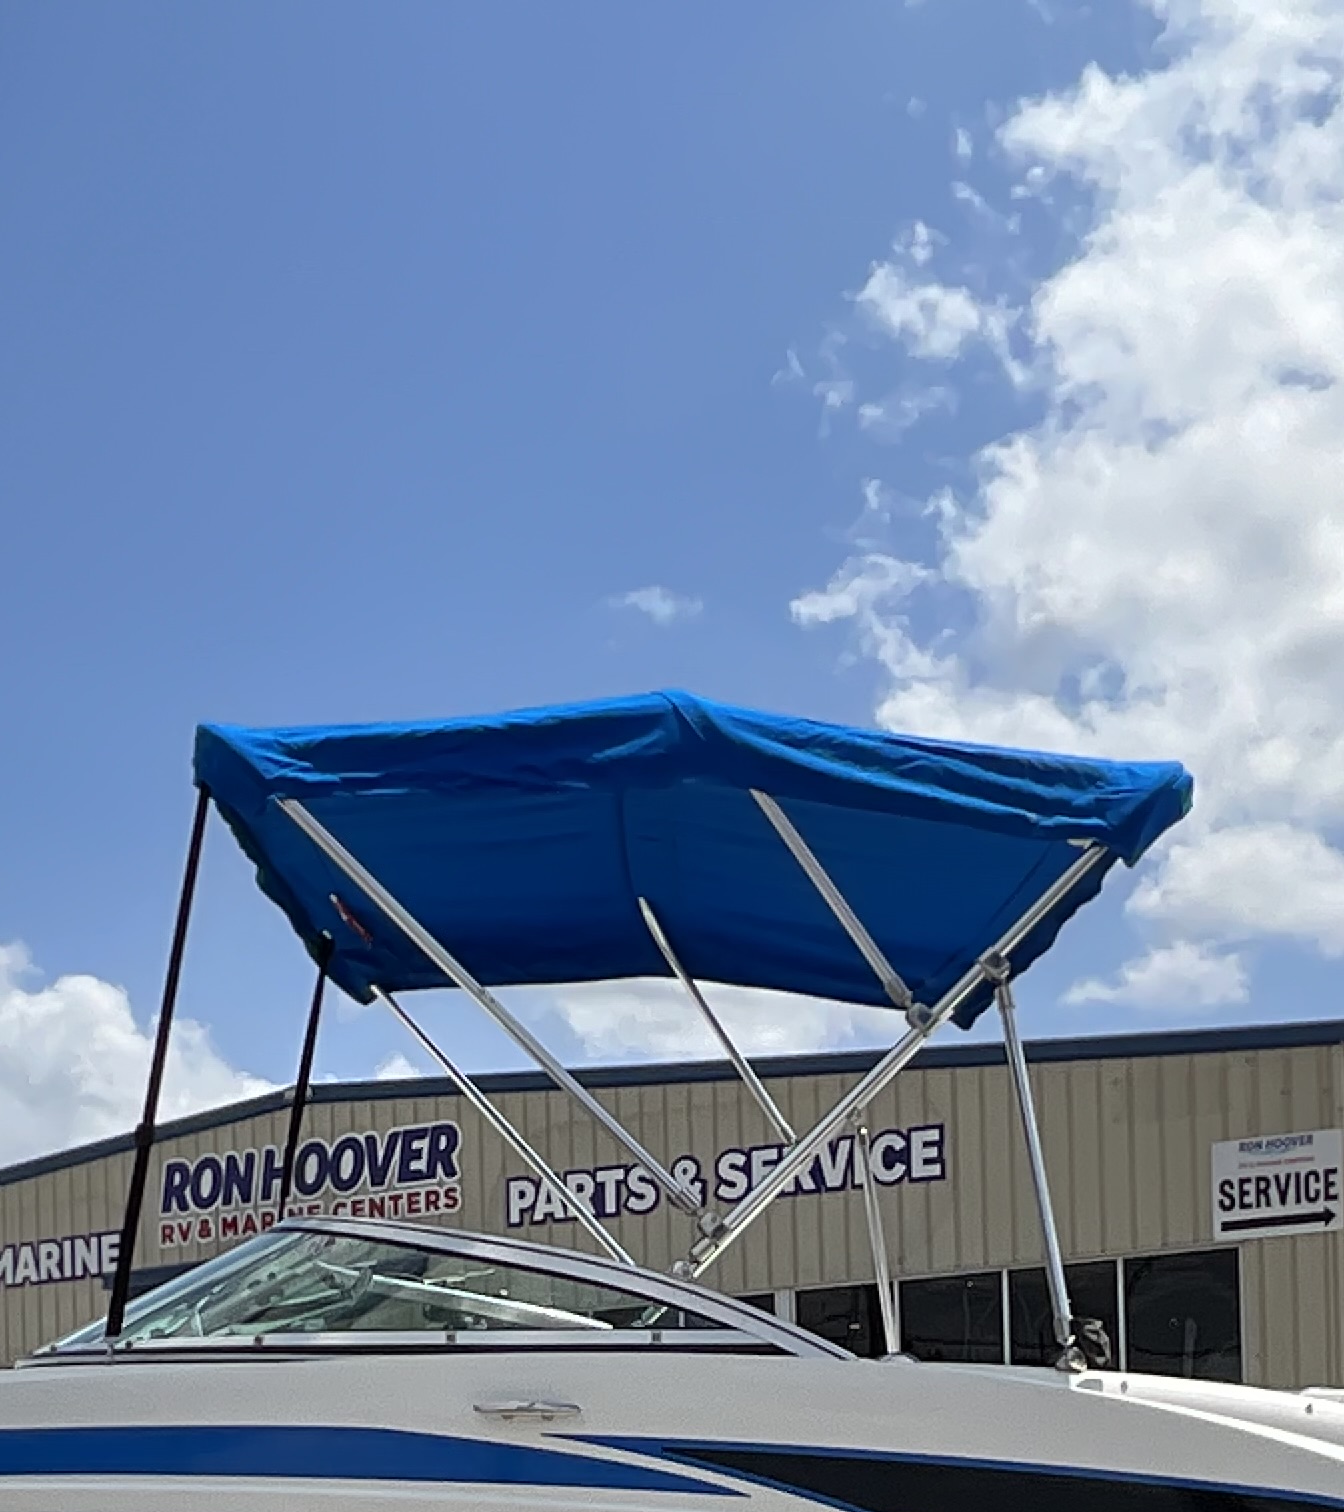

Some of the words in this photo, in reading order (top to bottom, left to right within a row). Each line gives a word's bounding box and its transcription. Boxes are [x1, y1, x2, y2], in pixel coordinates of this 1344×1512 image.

[161, 1152, 255, 1214] RON
[261, 1123, 459, 1201] HOOVER
[506, 1163, 660, 1228] PARTS
[670, 1154, 707, 1211] &
[714, 1122, 946, 1205] SERVICE
[1218, 1167, 1339, 1212] SERVICE
[161, 1220, 193, 1244] RV
[197, 1218, 212, 1240] &
[221, 1204, 322, 1238] MARE
[332, 1187, 460, 1218] CENTERS
